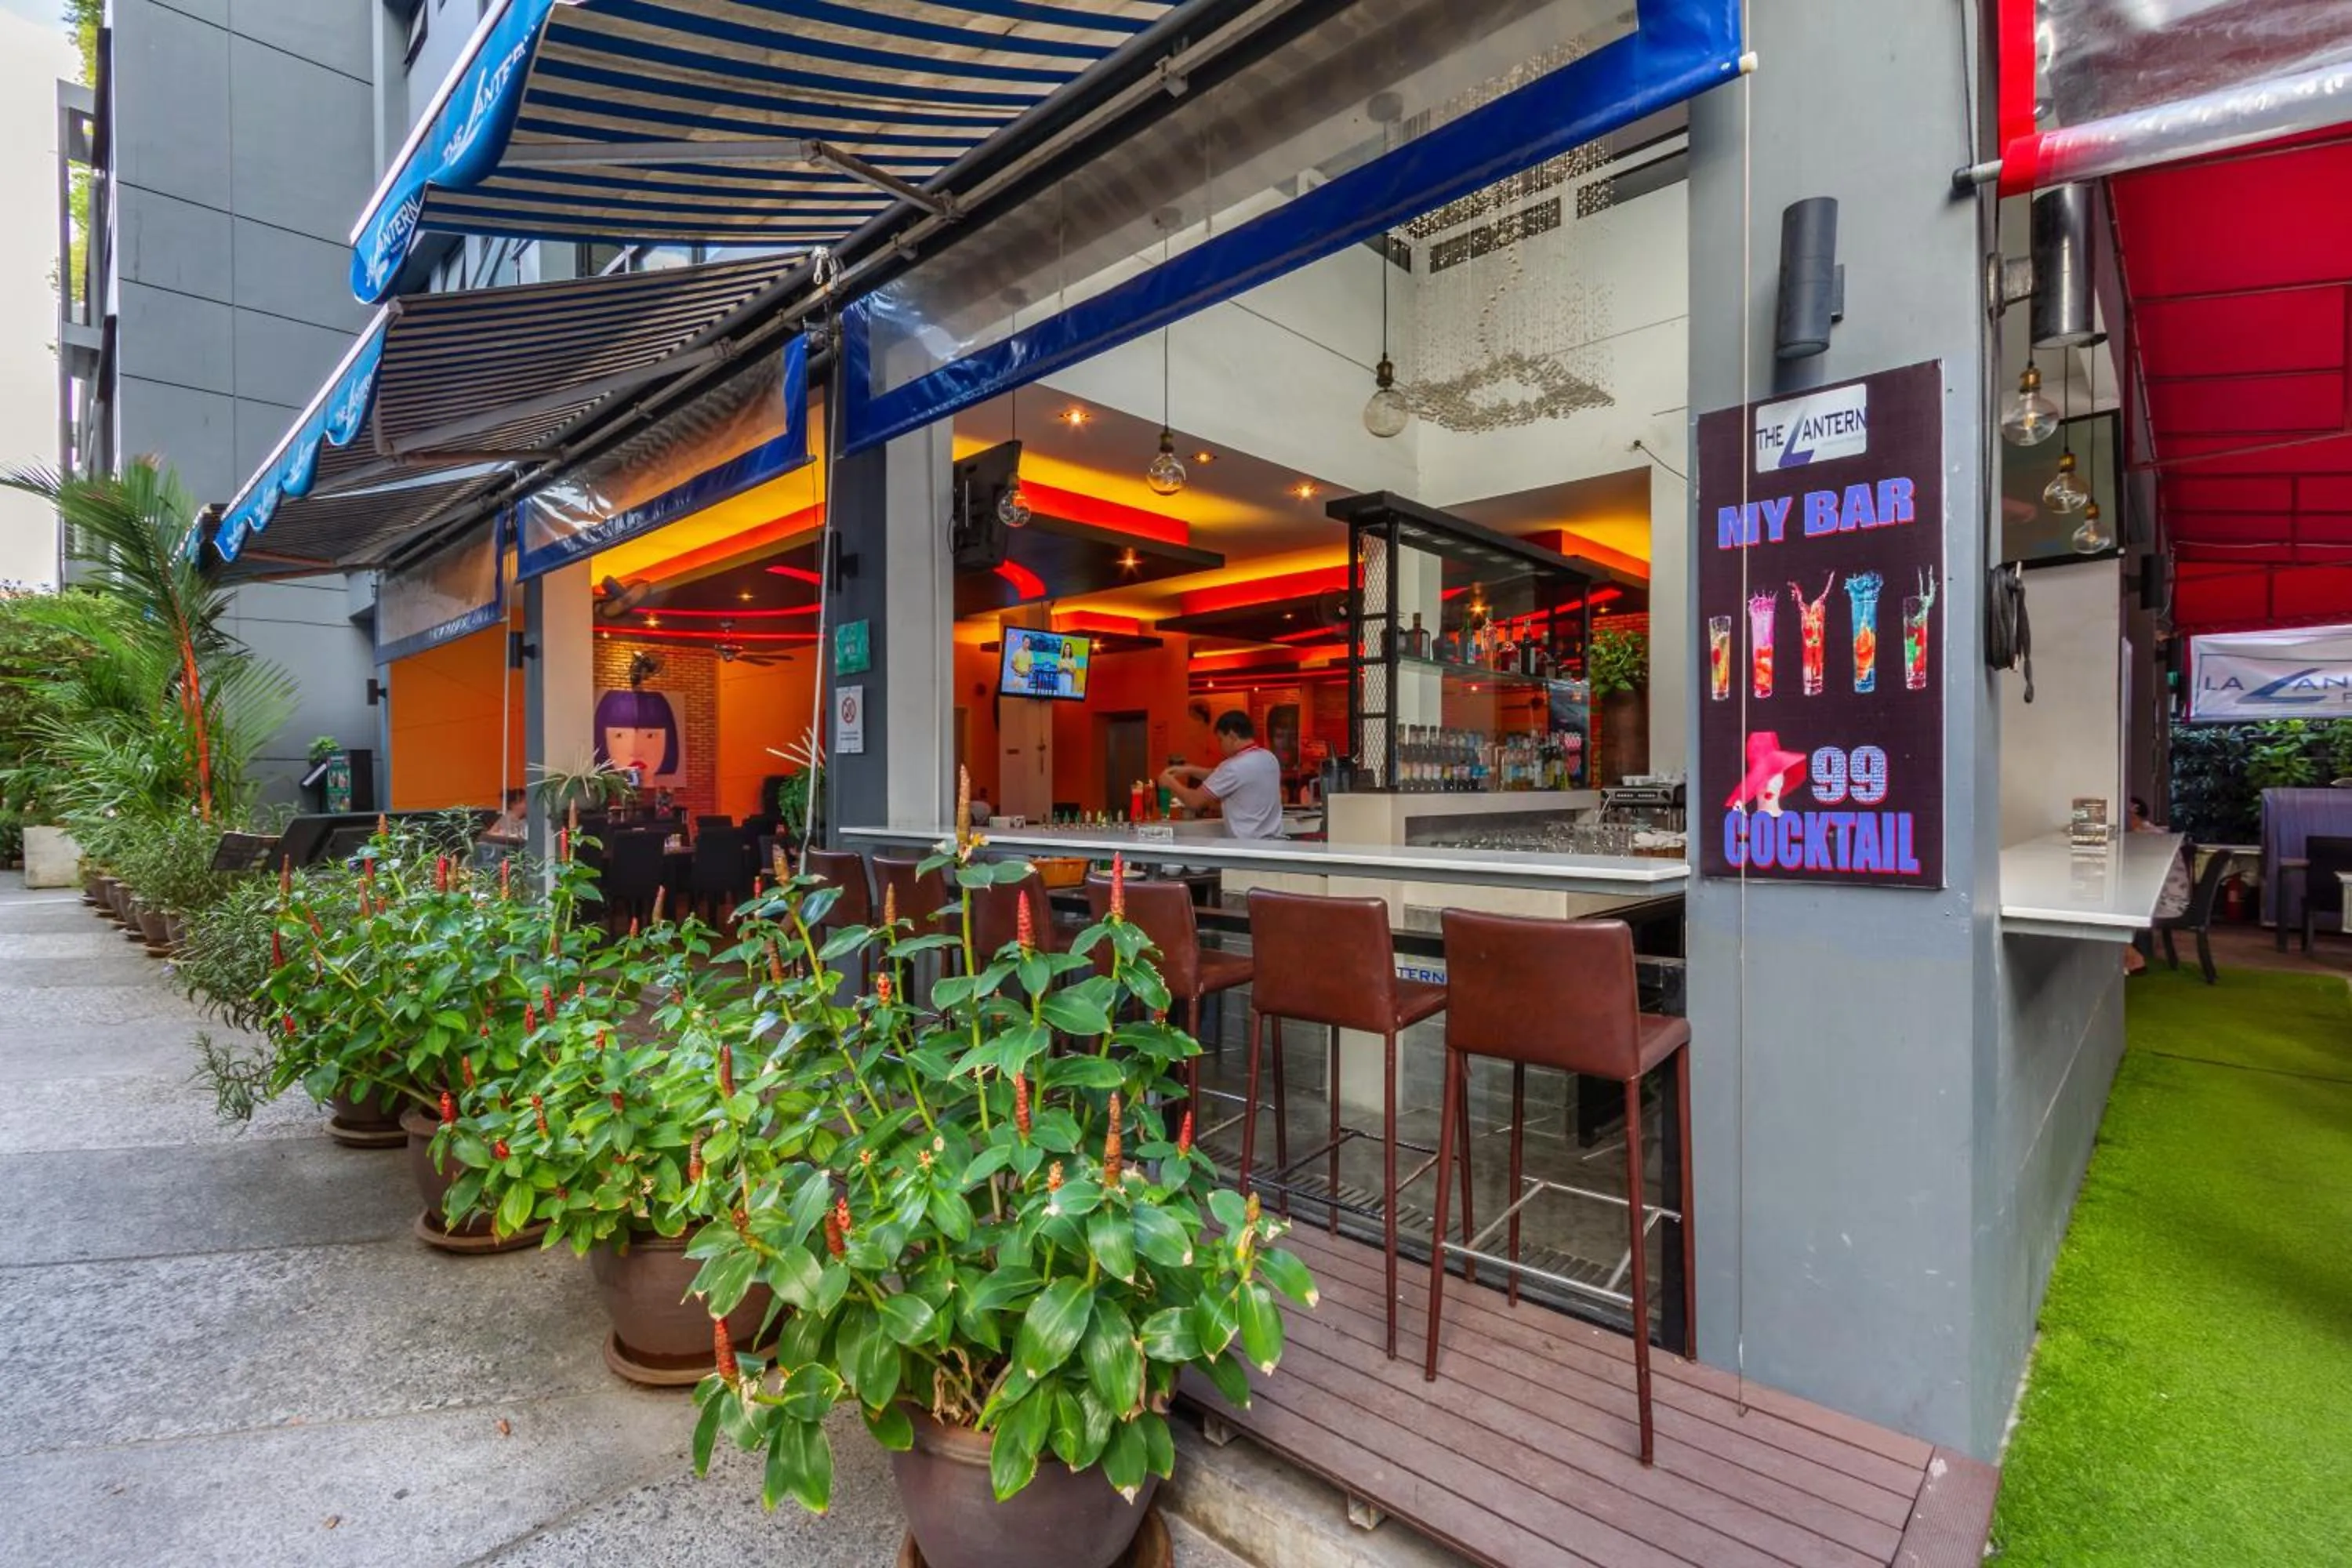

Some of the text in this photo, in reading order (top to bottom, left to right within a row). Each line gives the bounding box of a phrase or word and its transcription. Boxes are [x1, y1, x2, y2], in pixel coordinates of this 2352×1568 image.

[1756, 406, 1867, 467] THE LANTERN
[1718, 477, 1915, 549] MY BAR
[2205, 675, 2244, 691] LA
[1811, 746, 1887, 804] 99
[1724, 810, 1921, 875] COCKTAIL
